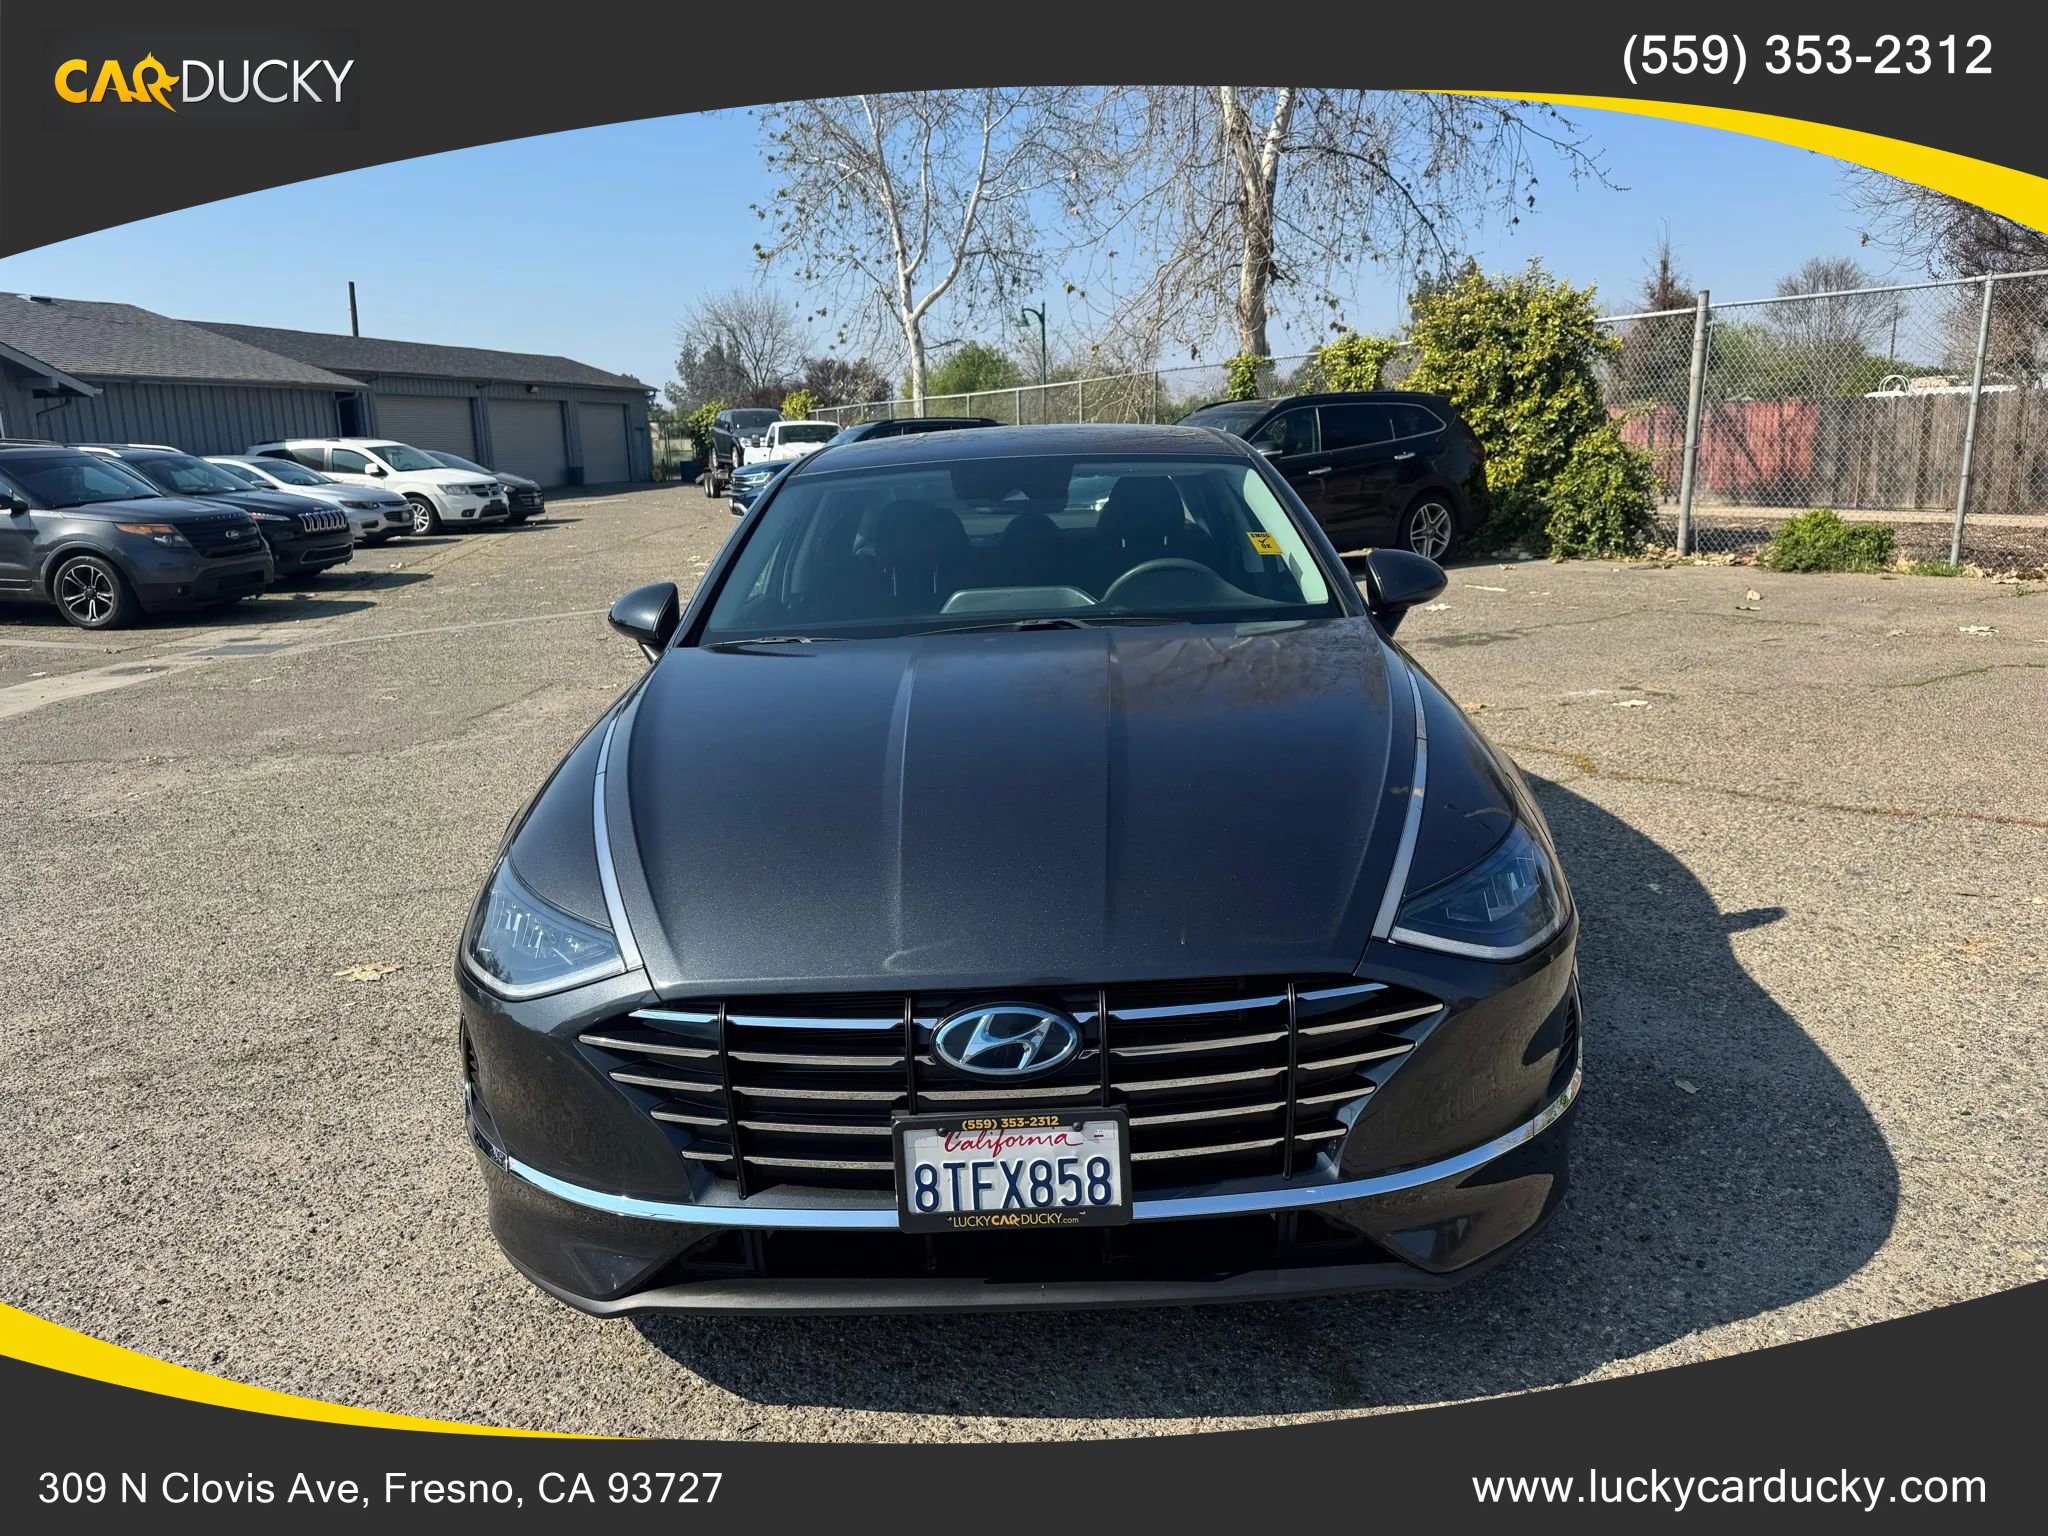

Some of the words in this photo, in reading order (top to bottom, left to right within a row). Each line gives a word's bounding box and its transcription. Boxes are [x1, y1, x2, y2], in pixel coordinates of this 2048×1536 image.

[961, 1118, 997, 1131] (559)
[1001, 1115, 1060, 1129] 353-2312
[944, 1129, 1083, 1158] California
[914, 1156, 1112, 1213] 8TFX858
